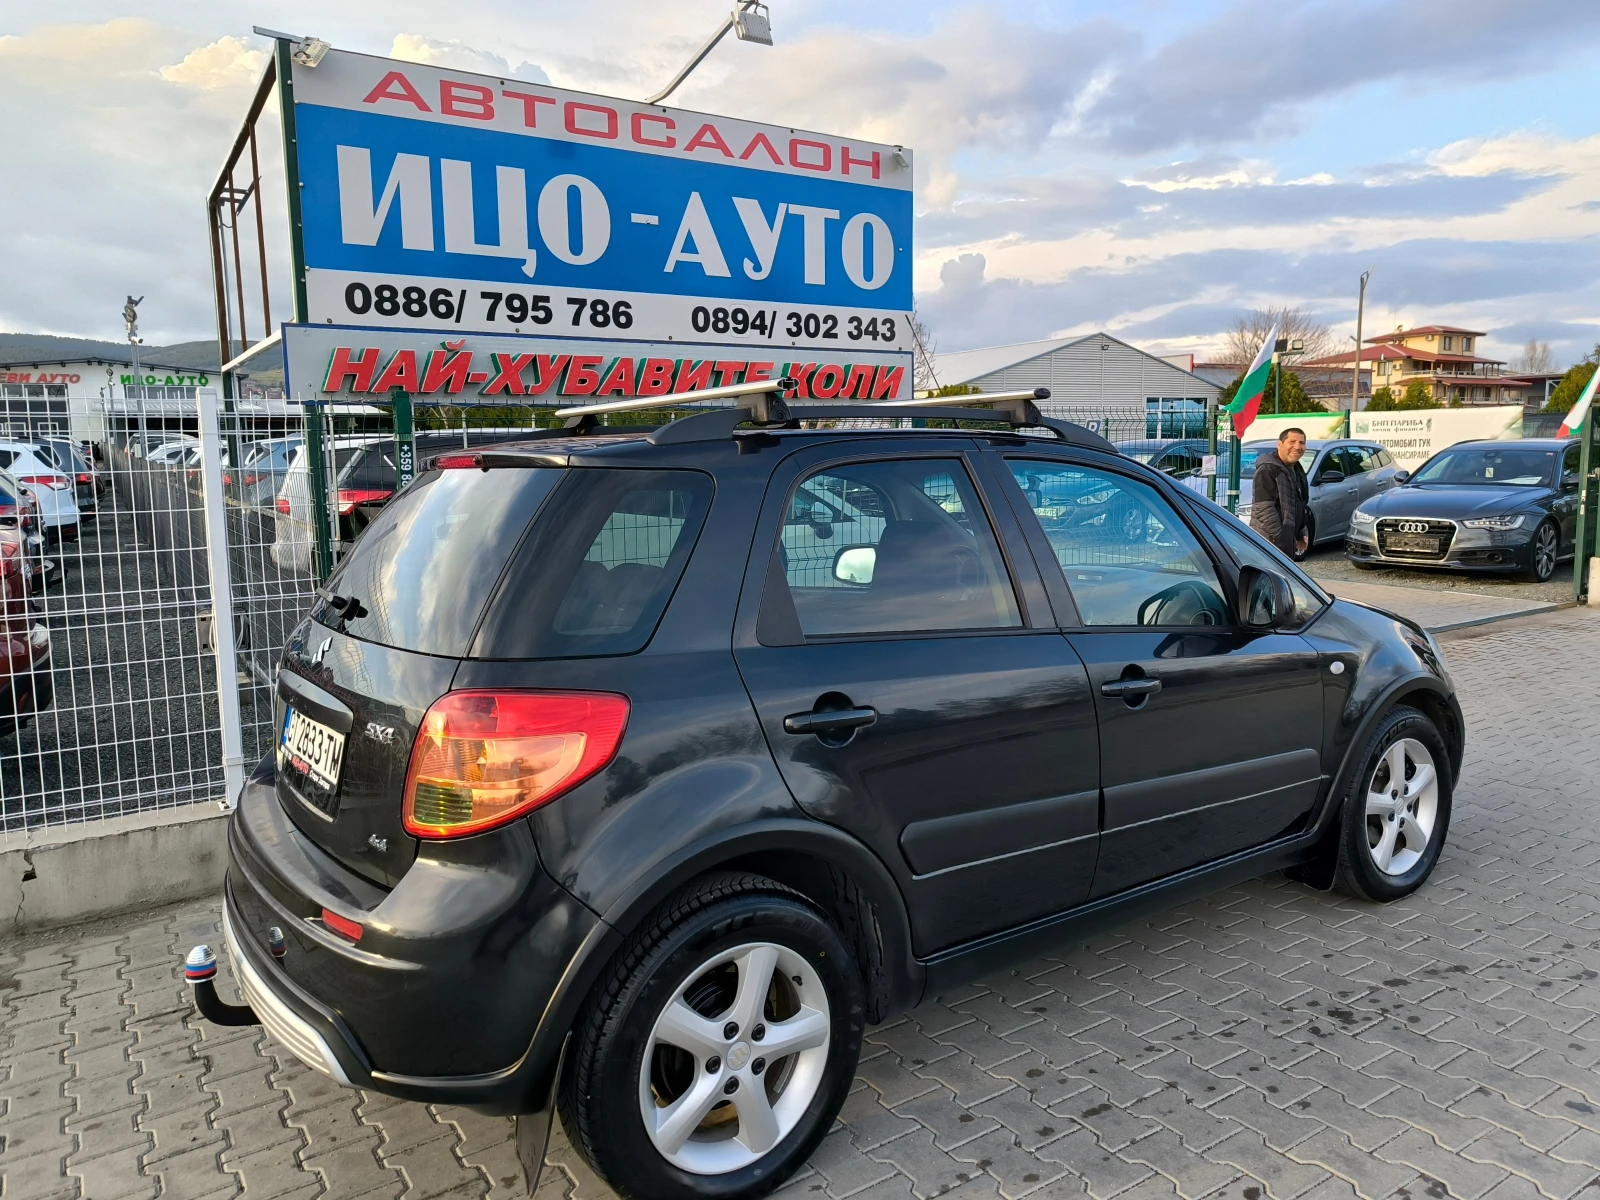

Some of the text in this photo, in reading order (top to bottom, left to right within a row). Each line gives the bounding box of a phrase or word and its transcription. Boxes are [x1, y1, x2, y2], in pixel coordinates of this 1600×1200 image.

[362, 70, 881, 180] АВТОСАЛОН
[344, 282, 634, 329] 0886/ 795 786
[691, 305, 896, 342] 0894/ 302 343
[37, 373, 81, 384] АУТО
[321, 338, 905, 399] НАЙ-ХУБАВИТЕ КОЛИ
[1390, 419, 1423, 427] ПАРИБА
[400, 444, 412, 471] +359
[365, 722, 395, 744] SX4
